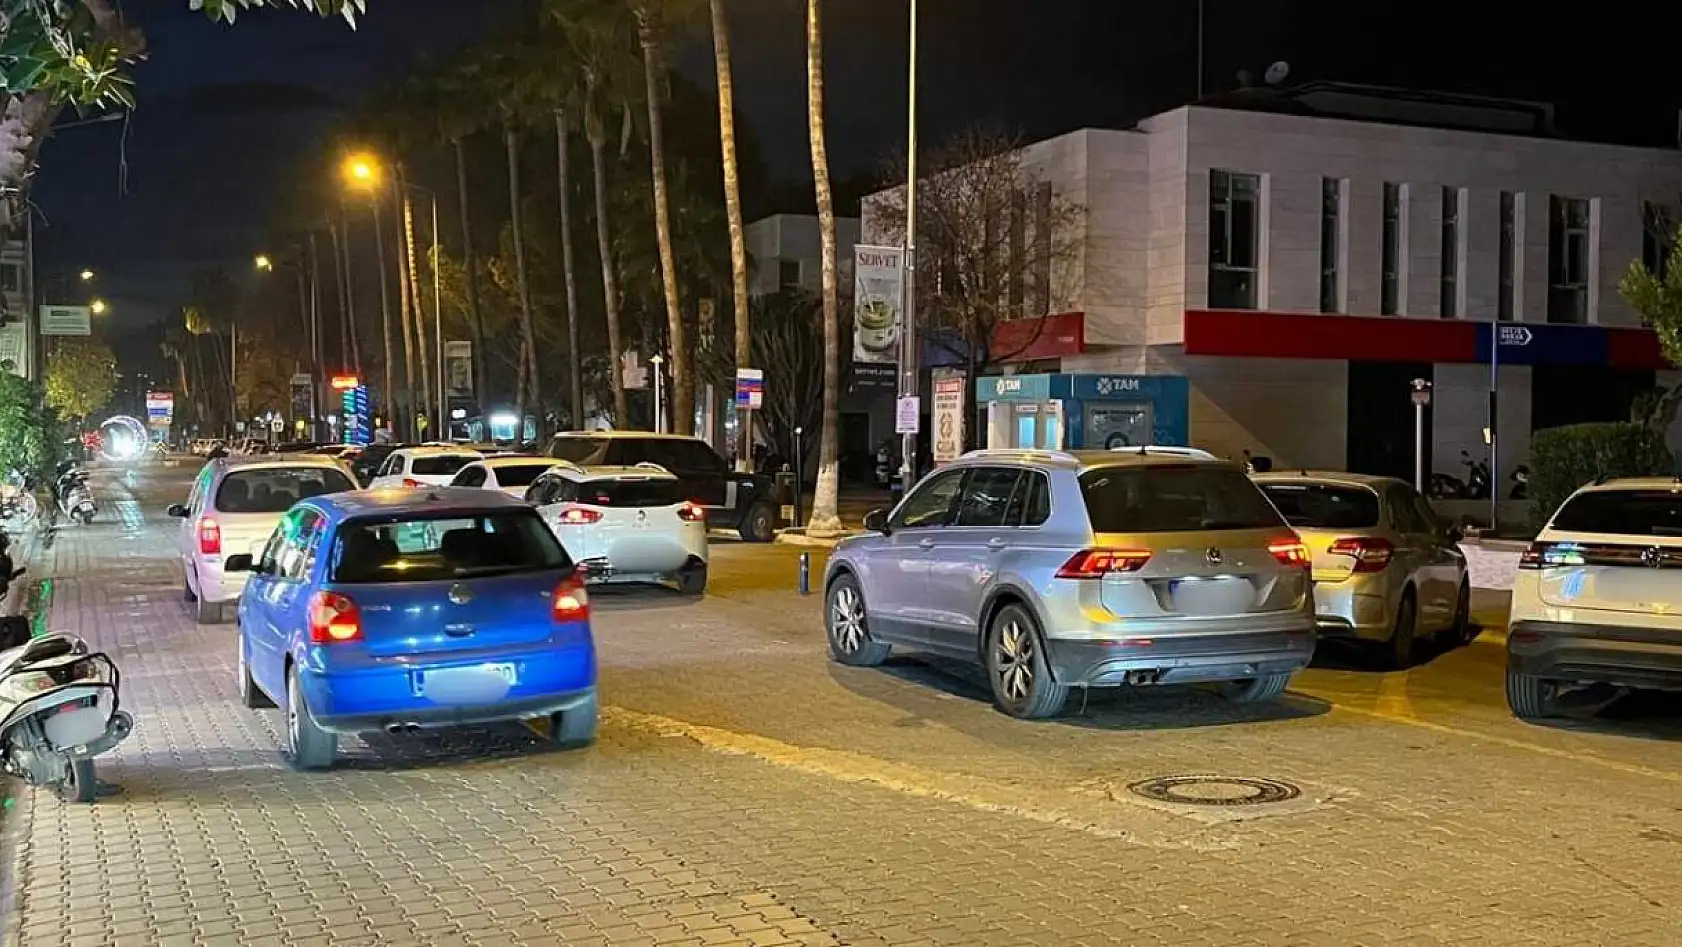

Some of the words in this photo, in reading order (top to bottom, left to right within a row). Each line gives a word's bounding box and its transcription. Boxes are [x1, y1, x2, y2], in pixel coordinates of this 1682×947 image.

[858, 251, 898, 268] SERVET
[1006, 379, 1021, 391] TAM
[1111, 379, 1140, 390] TAM
